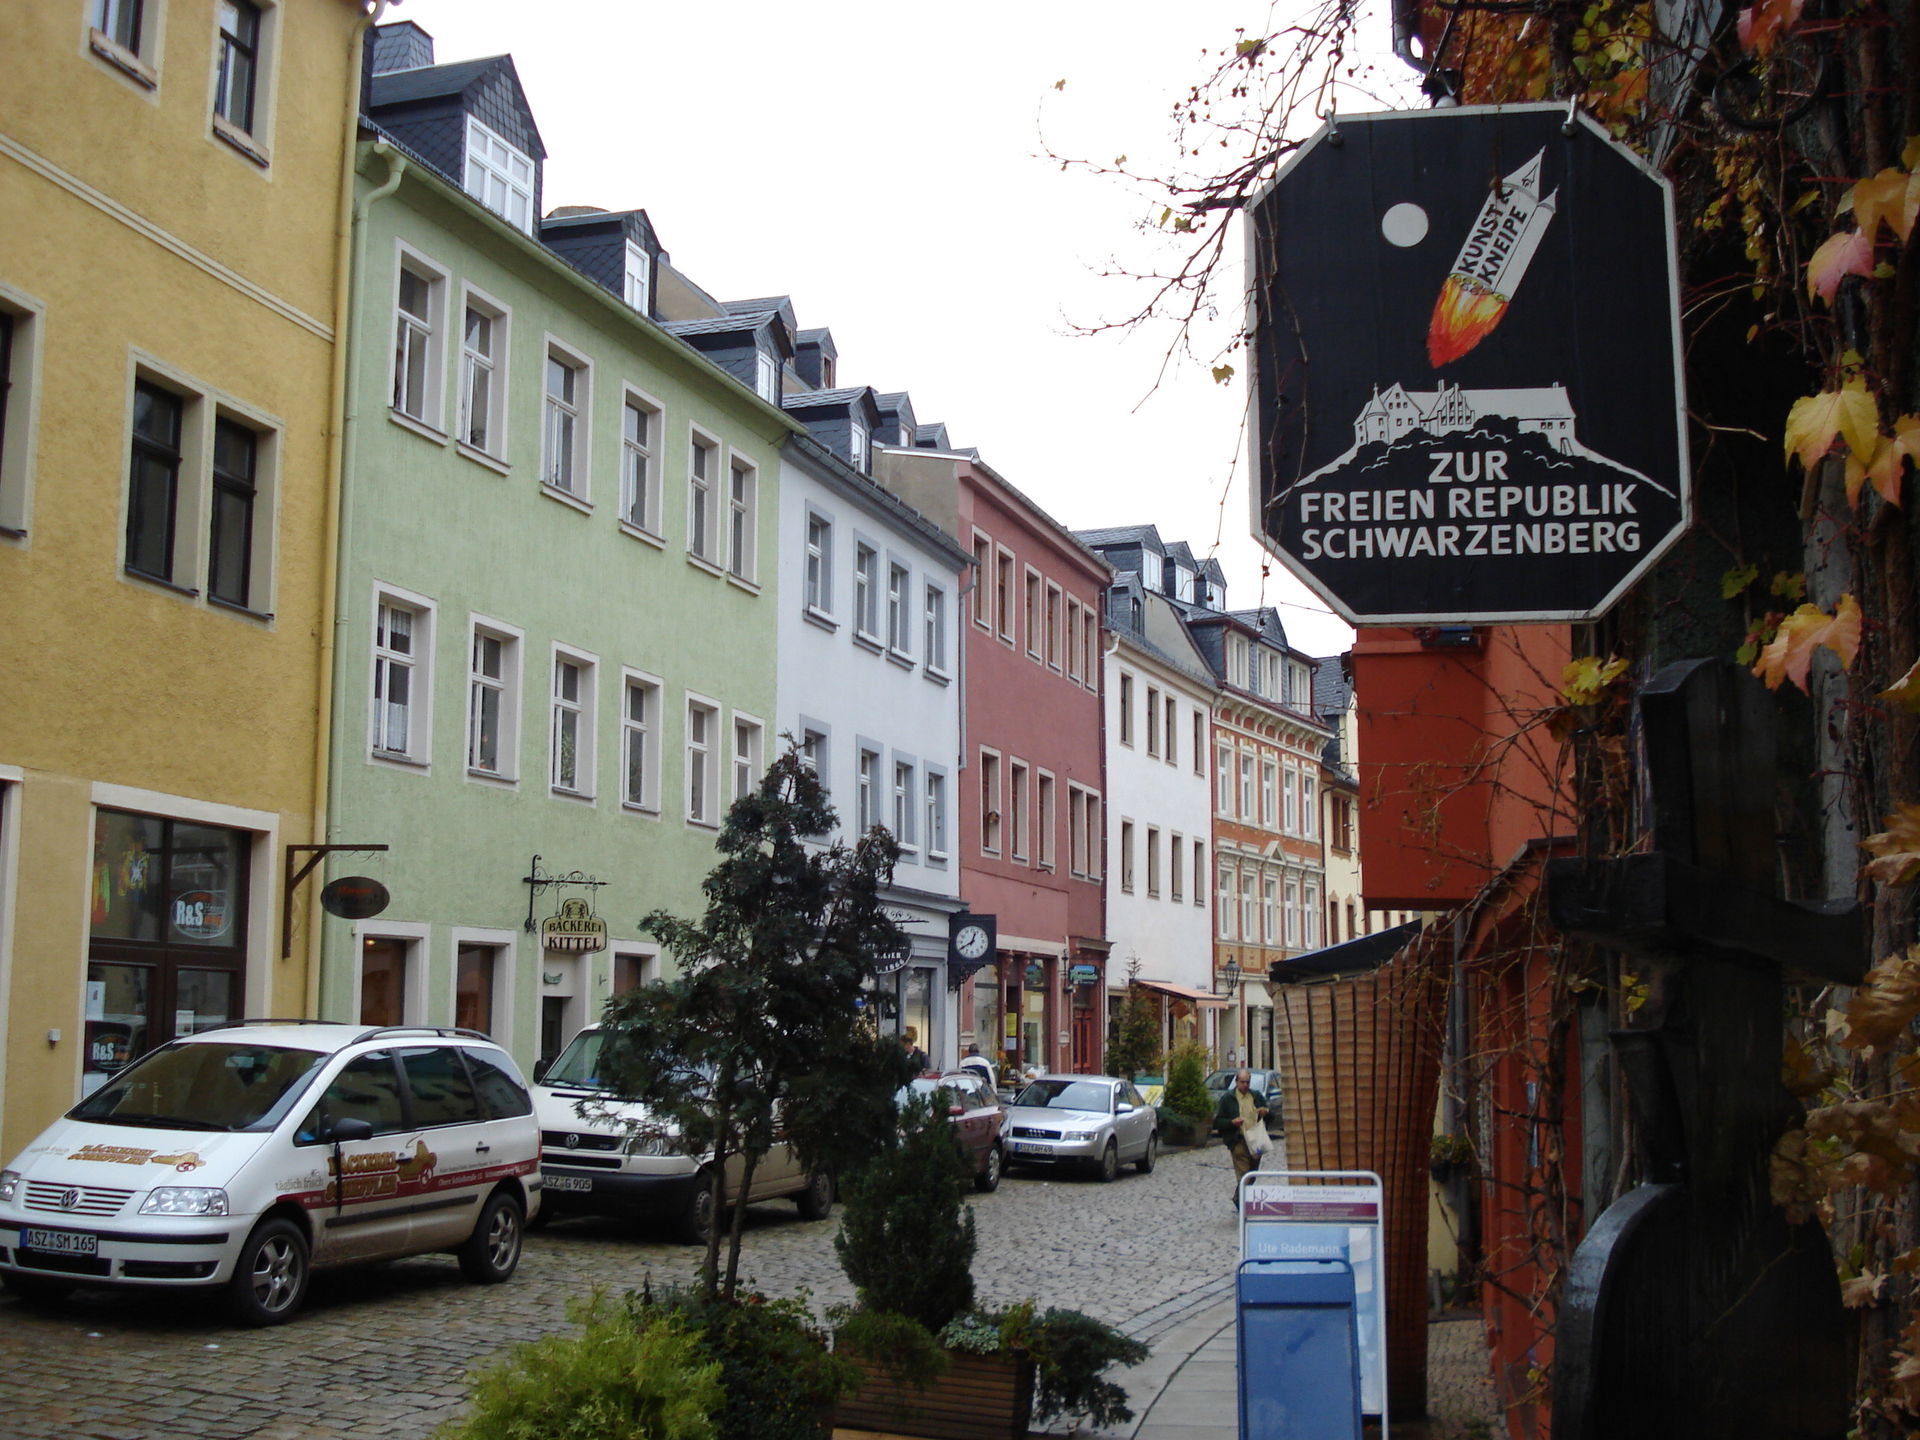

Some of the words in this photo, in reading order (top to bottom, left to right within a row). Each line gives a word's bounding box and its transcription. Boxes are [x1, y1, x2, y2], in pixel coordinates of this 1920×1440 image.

[1457, 203, 1503, 274] KUNST
[1477, 205, 1528, 285] KNEIPE
[1428, 450, 1509, 484] ZUR
[1300, 489, 1435, 523] FREIEN
[1449, 483, 1638, 519] REPUBLIK
[1301, 521, 1642, 560] SCHWARZENBERG
[176, 900, 204, 927] R&S
[549, 937, 601, 951] KITTEL
[92, 1042, 115, 1061] R&S
[565, 1178, 571, 1187] G
[573, 1178, 592, 1189] 905
[28, 1231, 48, 1247] ASZ
[56, 1234, 71, 1250] SM
[74, 1236, 95, 1252] 165
[1258, 1243, 1278, 1254] Ute
[1280, 1242, 1341, 1254] Rademann
